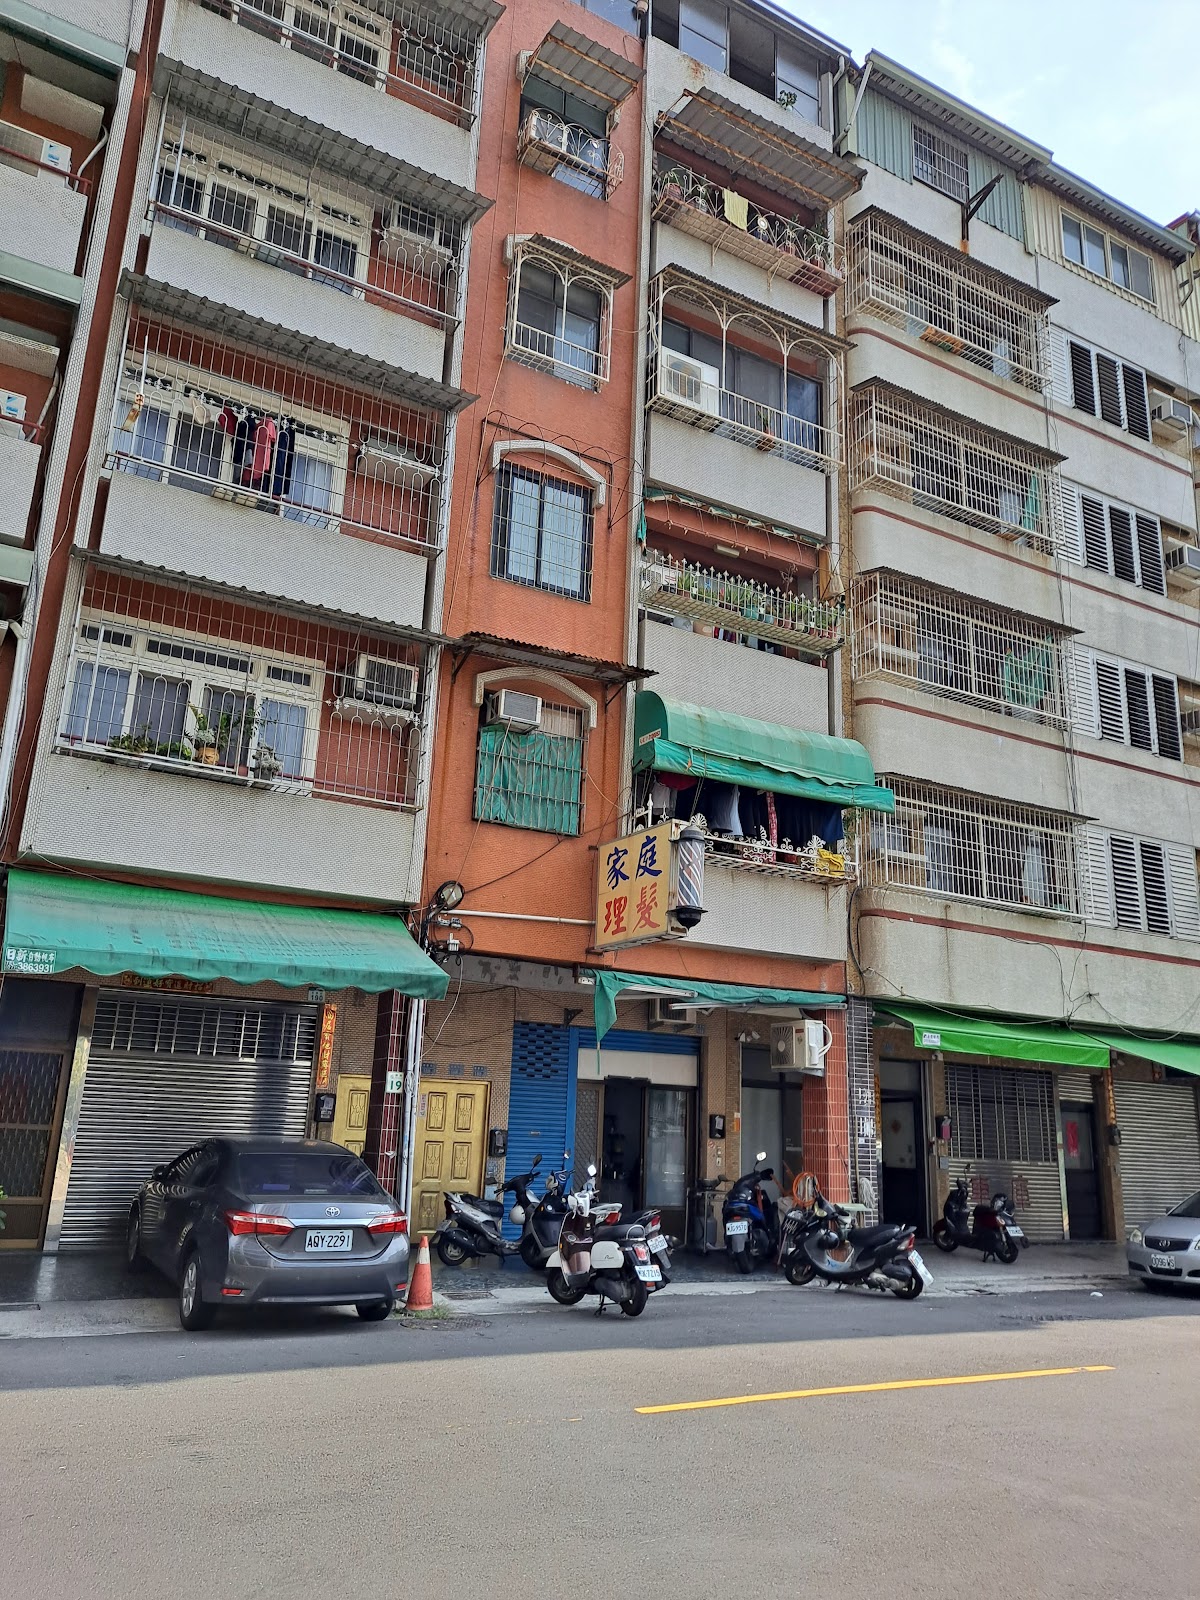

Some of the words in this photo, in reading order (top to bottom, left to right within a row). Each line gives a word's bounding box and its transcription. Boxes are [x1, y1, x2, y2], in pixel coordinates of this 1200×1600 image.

[606, 834, 663, 891] 家庭
[603, 881, 661, 936] 理髮
[306, 1235, 350, 1248] AQY-2291
